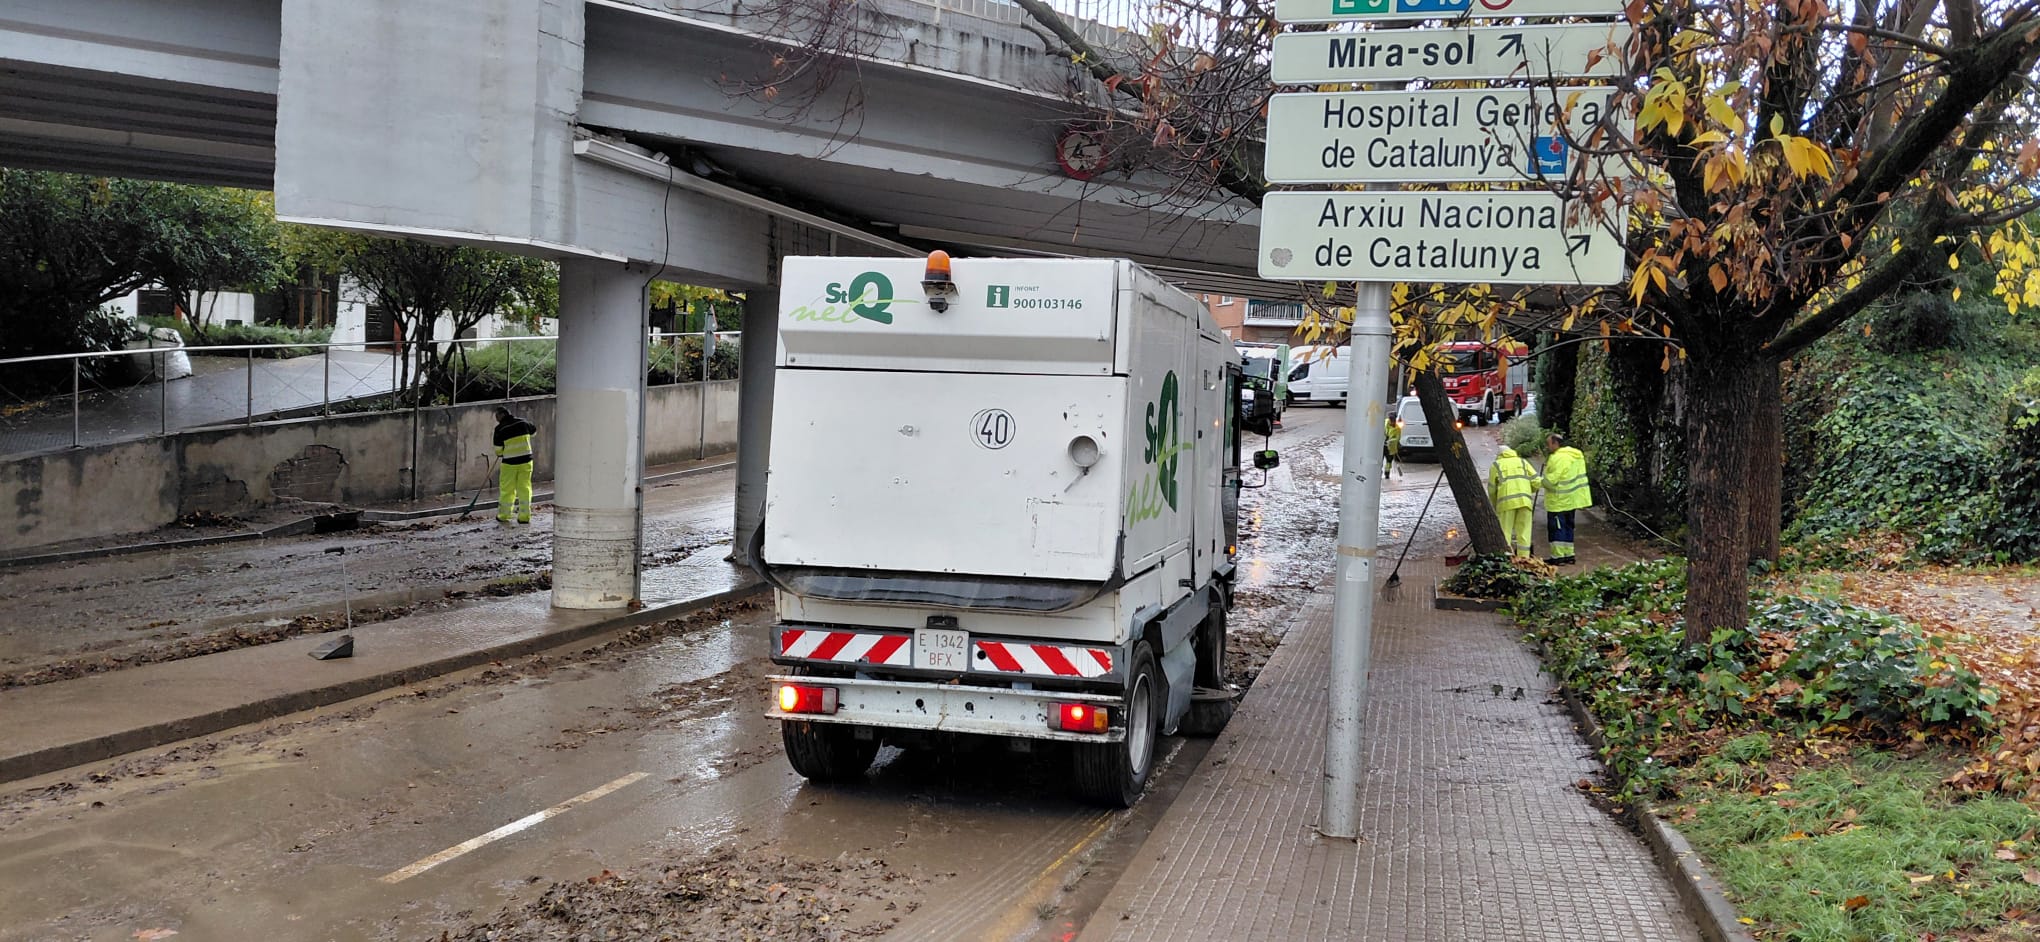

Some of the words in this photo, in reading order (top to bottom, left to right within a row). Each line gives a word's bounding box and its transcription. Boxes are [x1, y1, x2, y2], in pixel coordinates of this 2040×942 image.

[1327, 35, 1475, 68] Mira-sol
[1323, 97, 1459, 135] Hospital
[1321, 139, 1355, 168] de
[1367, 137, 1514, 175] Catalunya
[1318, 198, 1404, 228] Arxiu
[1419, 196, 1566, 228] Naciona
[1315, 238, 1352, 268] de
[1369, 237, 1541, 277] Catalunya
[1013, 298, 1083, 310] 900103146
[980, 413, 1009, 445] 40
[919, 633, 927, 647] E
[935, 634, 964, 649] 1342
[929, 653, 952, 665] BFX
